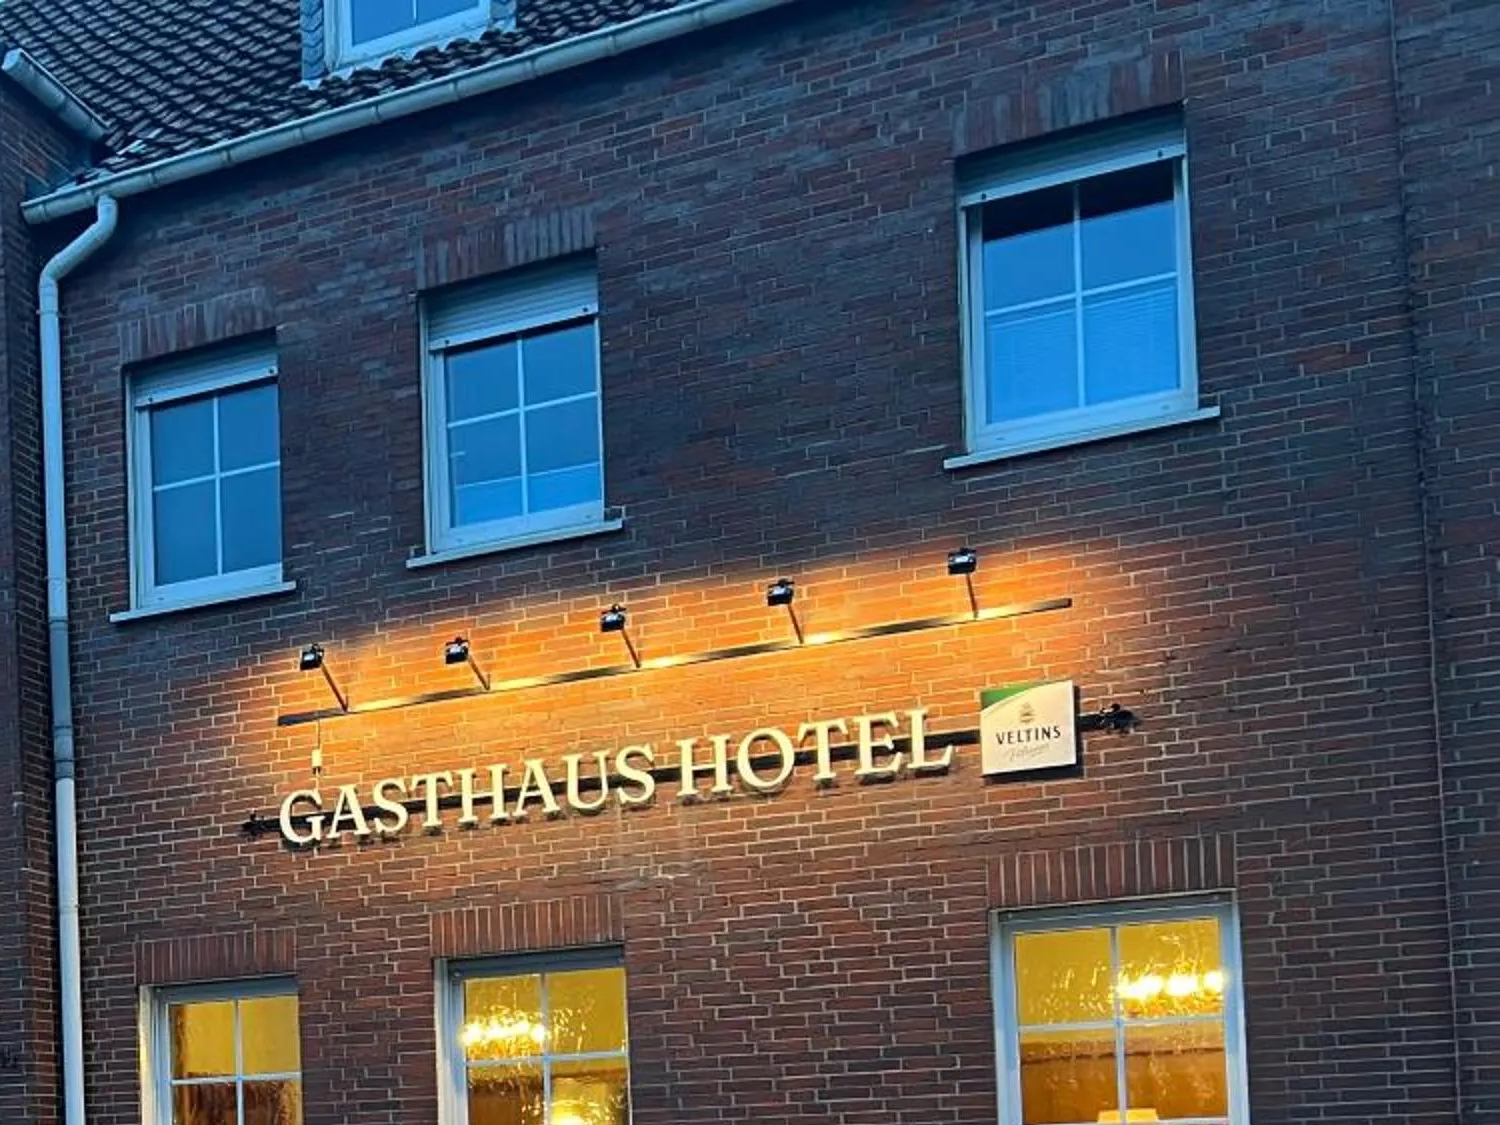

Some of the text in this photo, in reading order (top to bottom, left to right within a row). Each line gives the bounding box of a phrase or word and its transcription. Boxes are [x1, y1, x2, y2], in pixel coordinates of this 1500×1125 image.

[995, 725, 1062, 745] VELTINS
[279, 707, 953, 844] GASTHAUS HOTEL
